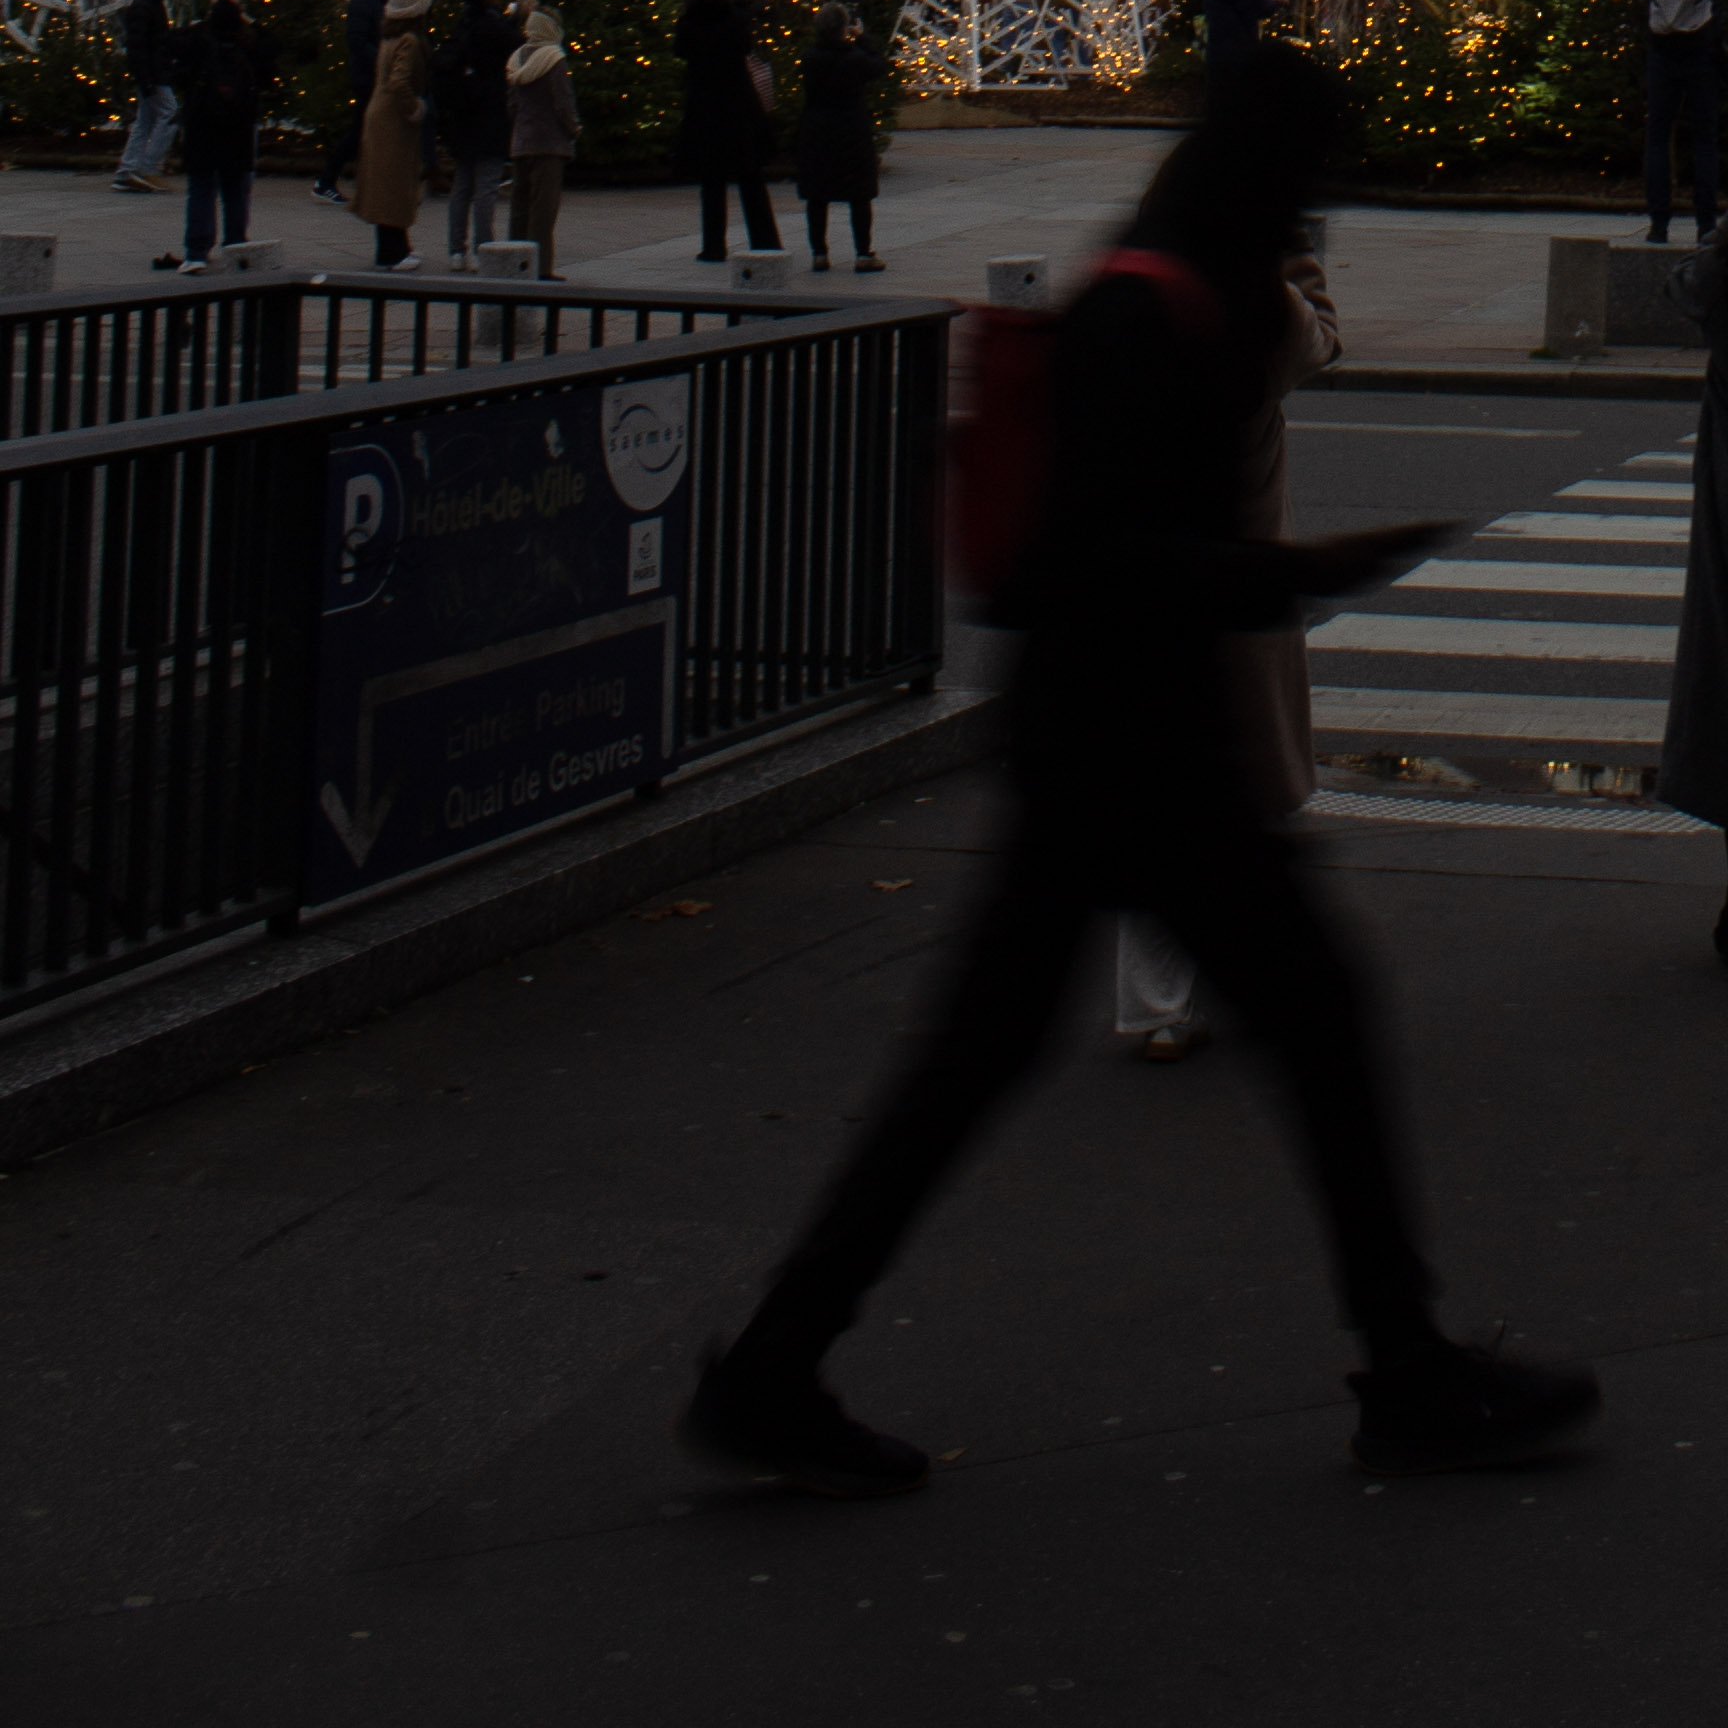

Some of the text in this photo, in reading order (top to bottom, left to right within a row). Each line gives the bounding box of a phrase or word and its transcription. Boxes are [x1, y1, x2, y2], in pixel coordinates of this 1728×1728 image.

[608, 424, 684, 450] saemes
[339, 473, 384, 584] P
[535, 674, 625, 731] Parking
[443, 771, 505, 830] Quai
[511, 763, 541, 806] de
[548, 732, 645, 792] Gesvres
